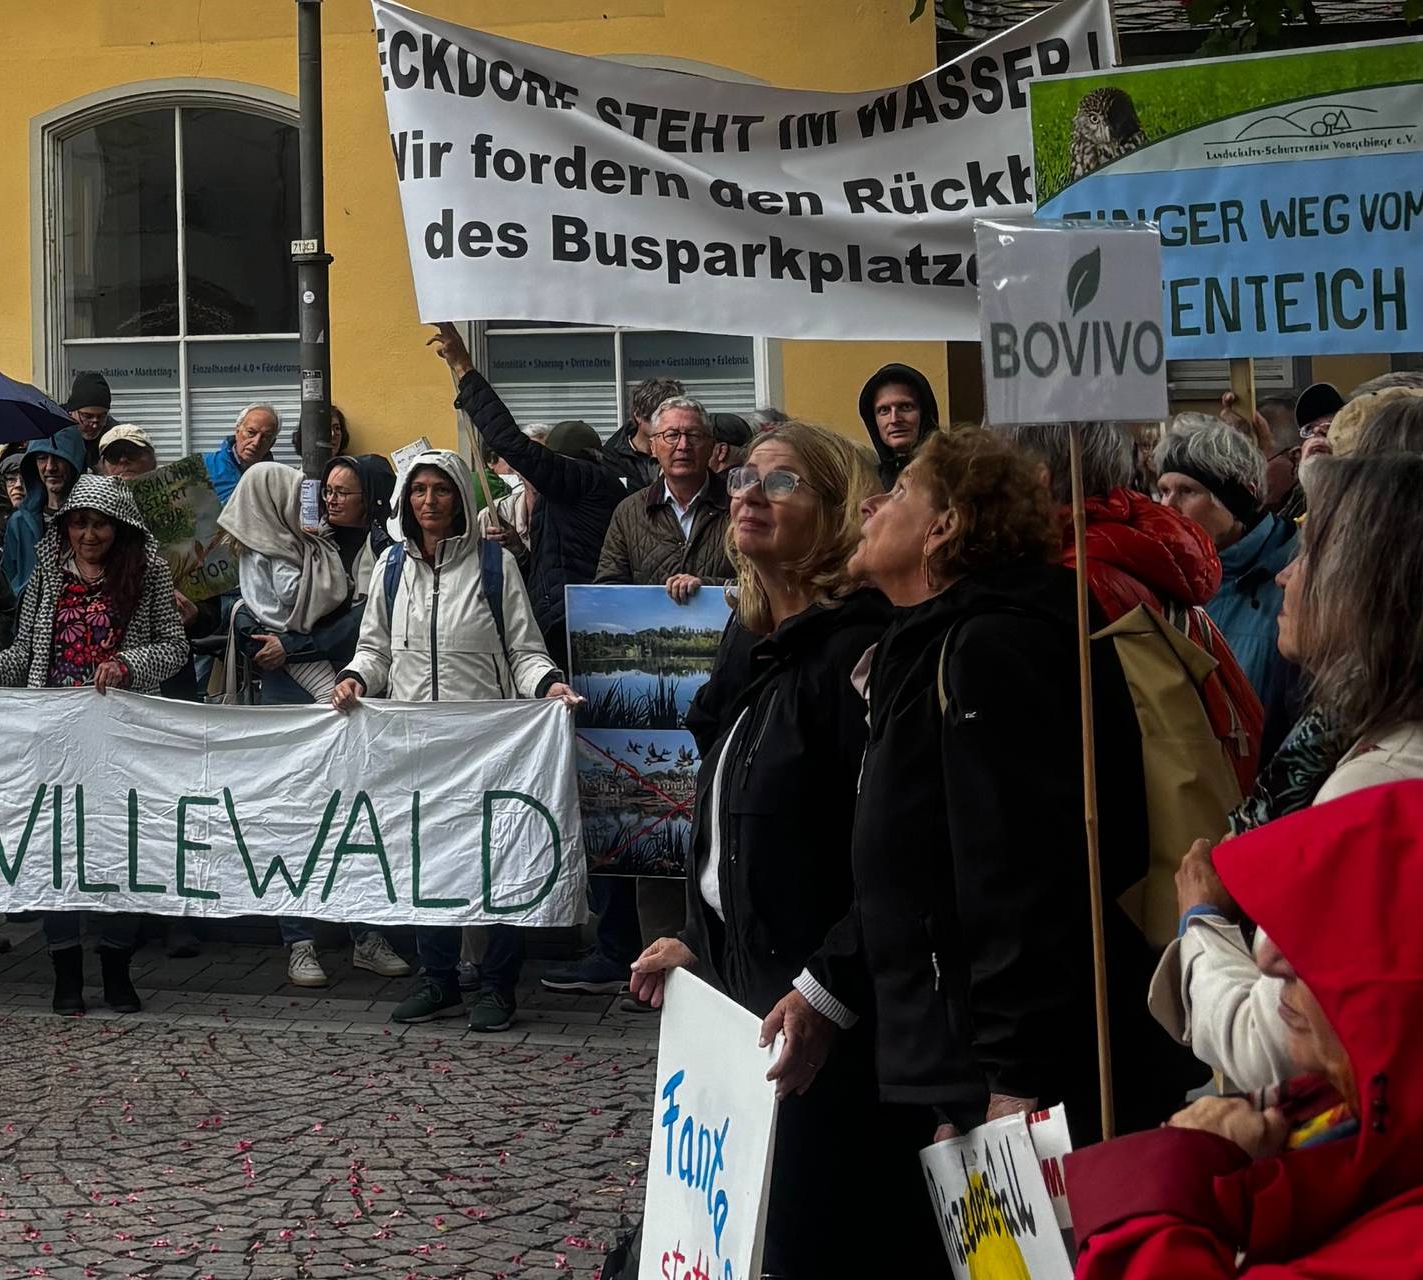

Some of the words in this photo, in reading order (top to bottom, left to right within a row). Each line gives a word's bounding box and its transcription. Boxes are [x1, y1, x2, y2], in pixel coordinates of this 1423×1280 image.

[596, 96, 764, 153] STEHT
[779, 109, 842, 150] IM
[470, 133, 689, 200] fordern
[424, 208, 528, 261] des
[1260, 193, 1350, 240] WEG
[192, 363, 241, 375] Einzelhandel
[262, 362, 301, 375] Förderung
[989, 319, 1165, 380] BOVIVO
[188, 559, 228, 586] STOP
